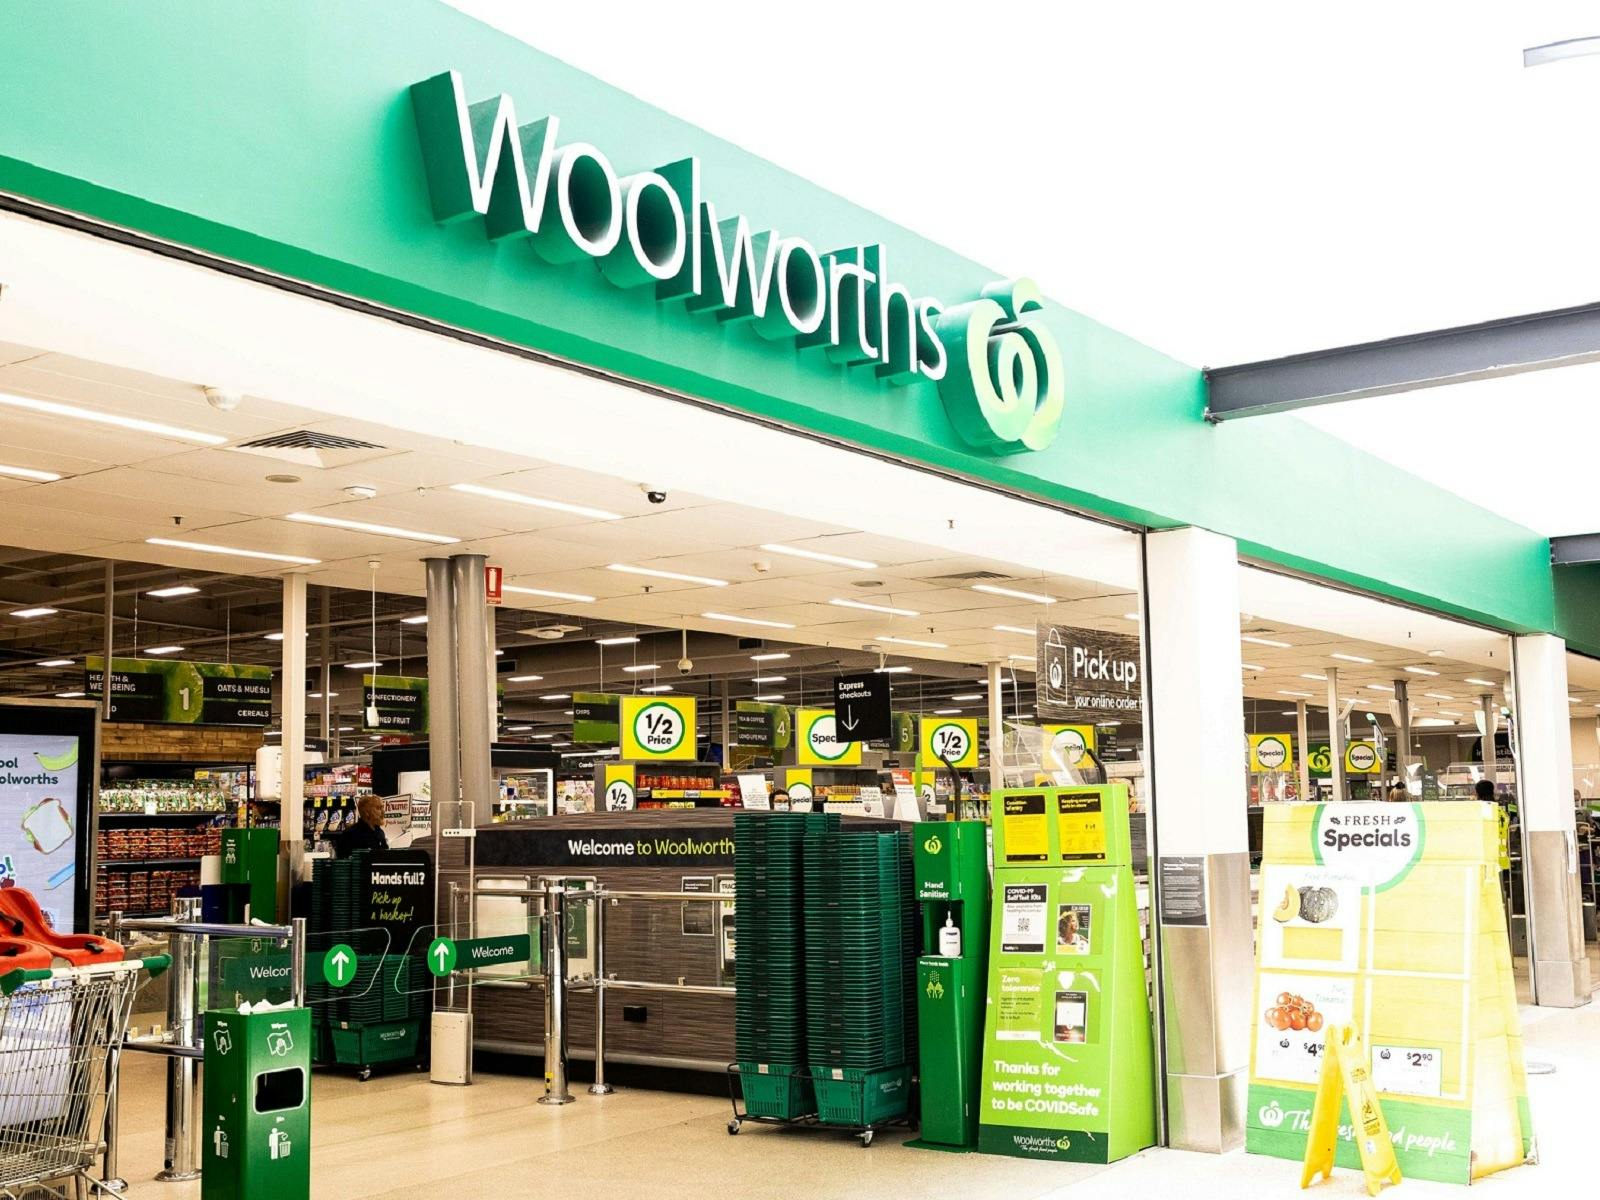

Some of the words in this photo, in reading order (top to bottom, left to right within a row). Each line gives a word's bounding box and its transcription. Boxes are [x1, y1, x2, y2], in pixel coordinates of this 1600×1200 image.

[447, 69, 948, 383] Woolworths
[1073, 647, 1110, 680] Pick
[1113, 660, 1137, 690] up
[89, 674, 121, 682] HEATH
[89, 682, 136, 692] WEBEING
[217, 684, 237, 693] OATS
[238, 685, 242, 693] &
[244, 685, 270, 694] MUESLI
[839, 682, 864, 692] Express
[178, 687, 190, 711] 1
[366, 693, 417, 702] CONFECTIONERY
[839, 690, 872, 699] checkouts
[1074, 696, 1090, 709] your
[1092, 694, 1115, 708] online
[1116, 696, 1138, 709] order
[238, 710, 270, 718] CEREALS
[380, 716, 392, 724] NED
[645, 713, 673, 735] 1/2
[776, 720, 786, 737] 4
[647, 736, 672, 745] Price
[812, 733, 836, 745] Spec
[902, 728, 908, 742] 5
[938, 732, 962, 748] 1/2
[942, 748, 960, 756] Price
[1258, 750, 1284, 758] Special
[1351, 754, 1374, 762] Special
[611, 788, 628, 804] 1/2
[792, 796, 812, 804] pecial
[1344, 816, 1390, 826] FRESH
[1324, 828, 1411, 852] Specials
[568, 838, 635, 856] Welcome
[637, 840, 652, 856] to
[654, 838, 736, 854] Woolworth
[371, 872, 402, 886] Hands
[403, 872, 426, 886] full?
[372, 891, 391, 904] Pick
[920, 890, 950, 898] Sanitiser
[472, 945, 514, 959] Welcome
[250, 966, 292, 979] Welco
[1002, 975, 1020, 983] Zero
[1002, 984, 1040, 992] tolerance
[993, 1060, 1040, 1075] Thanks
[1042, 1062, 1061, 1076] for
[992, 1080, 1042, 1096] working
[1044, 1082, 1102, 1098] together
[992, 1098, 1006, 1110] to
[1007, 1098, 1023, 1111] be
[1024, 1098, 1099, 1116] COVIDSafe
[1284, 1110, 1311, 1131] Th
[1404, 1128, 1456, 1157] people
[1013, 1135, 1056, 1147] Woolworths
